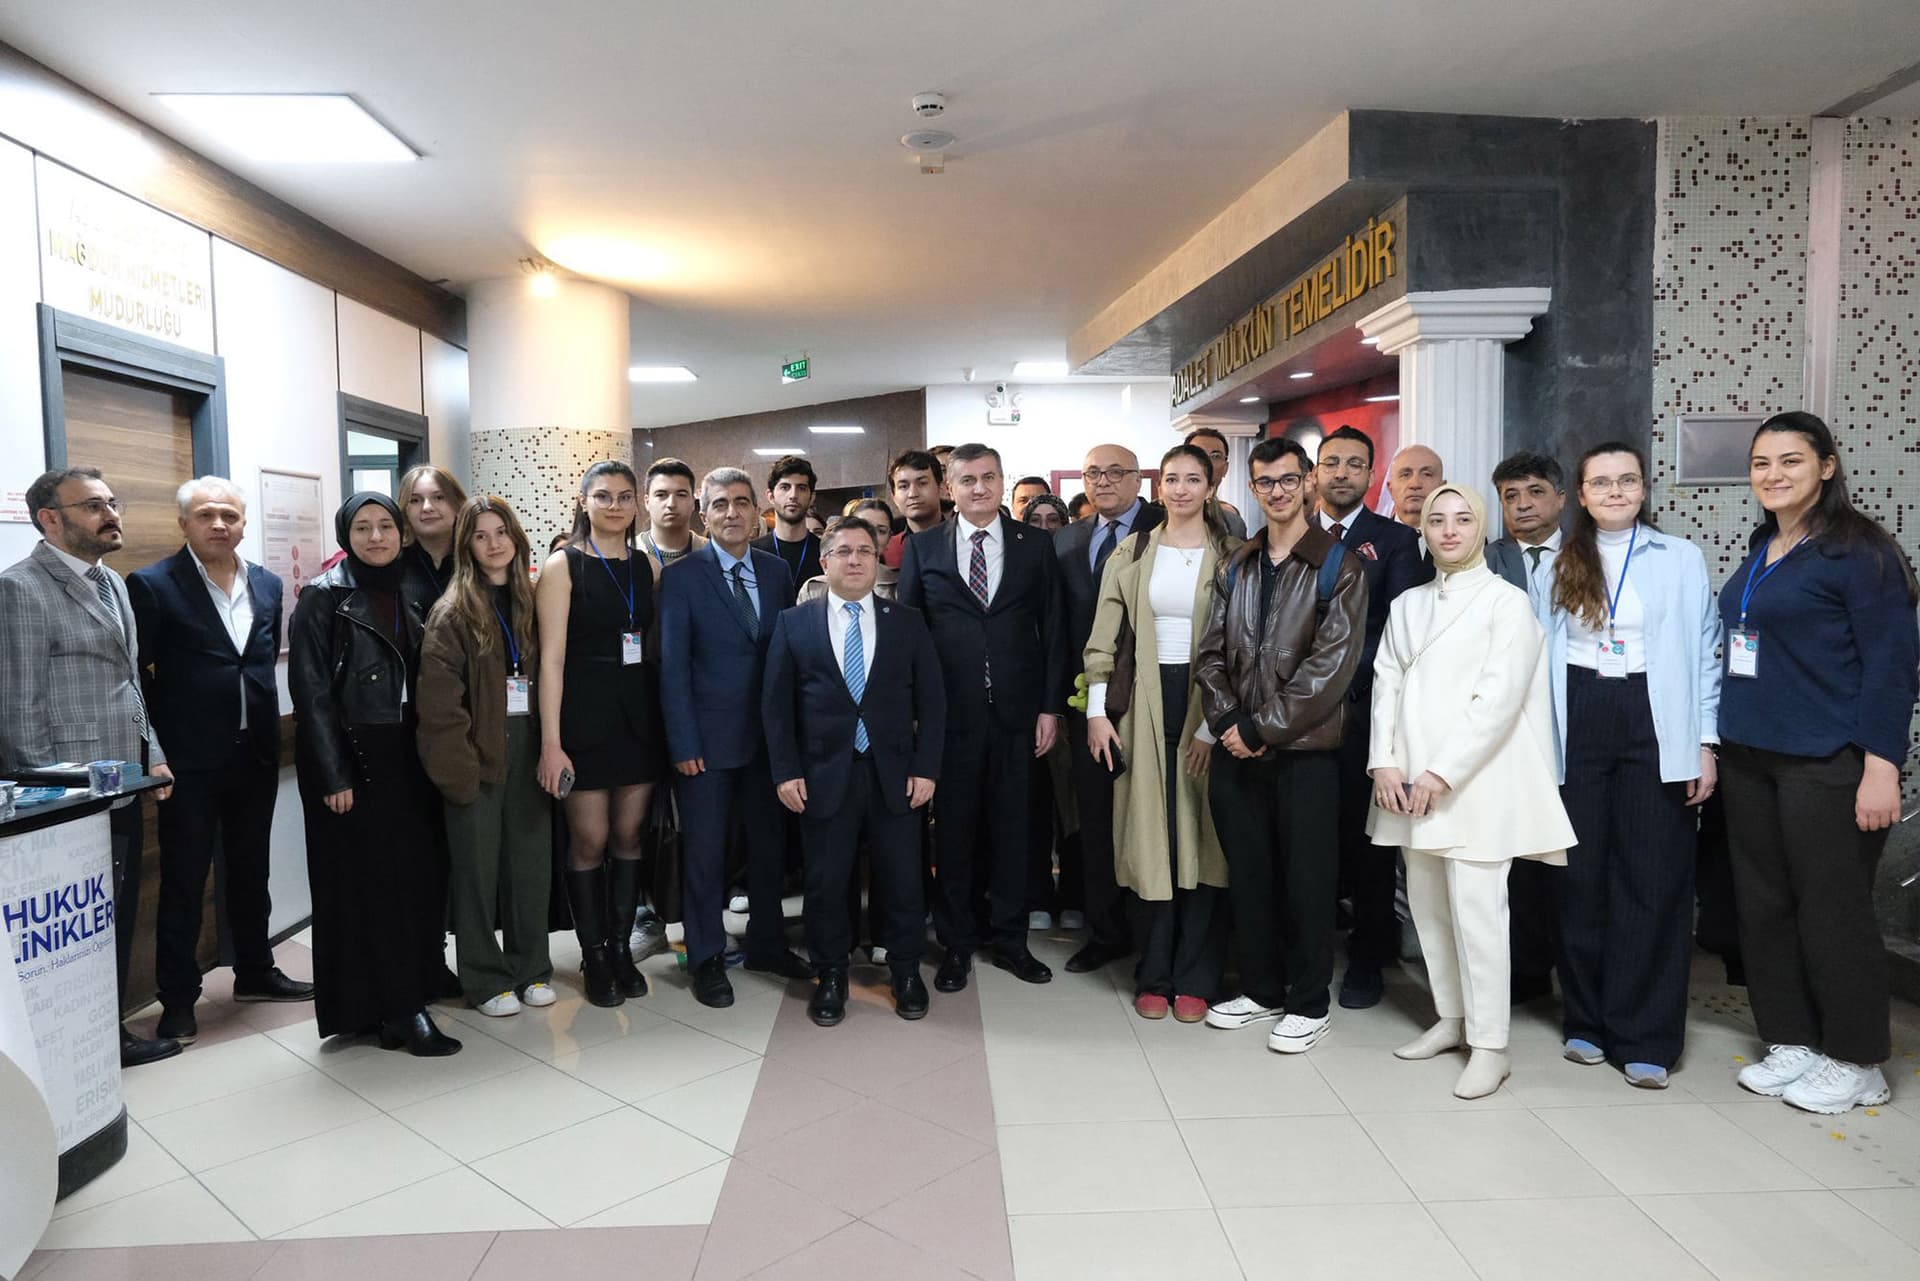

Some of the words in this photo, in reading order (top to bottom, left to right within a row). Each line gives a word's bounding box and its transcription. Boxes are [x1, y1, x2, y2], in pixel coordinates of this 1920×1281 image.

[1171, 349, 1213, 407] ADALET
[1216, 302, 1275, 381] MÜLKÜN
[1280, 217, 1396, 340] TEMELİDİR
[791, 361, 805, 372] EXIT
[3, 872, 107, 933] HUKUK
